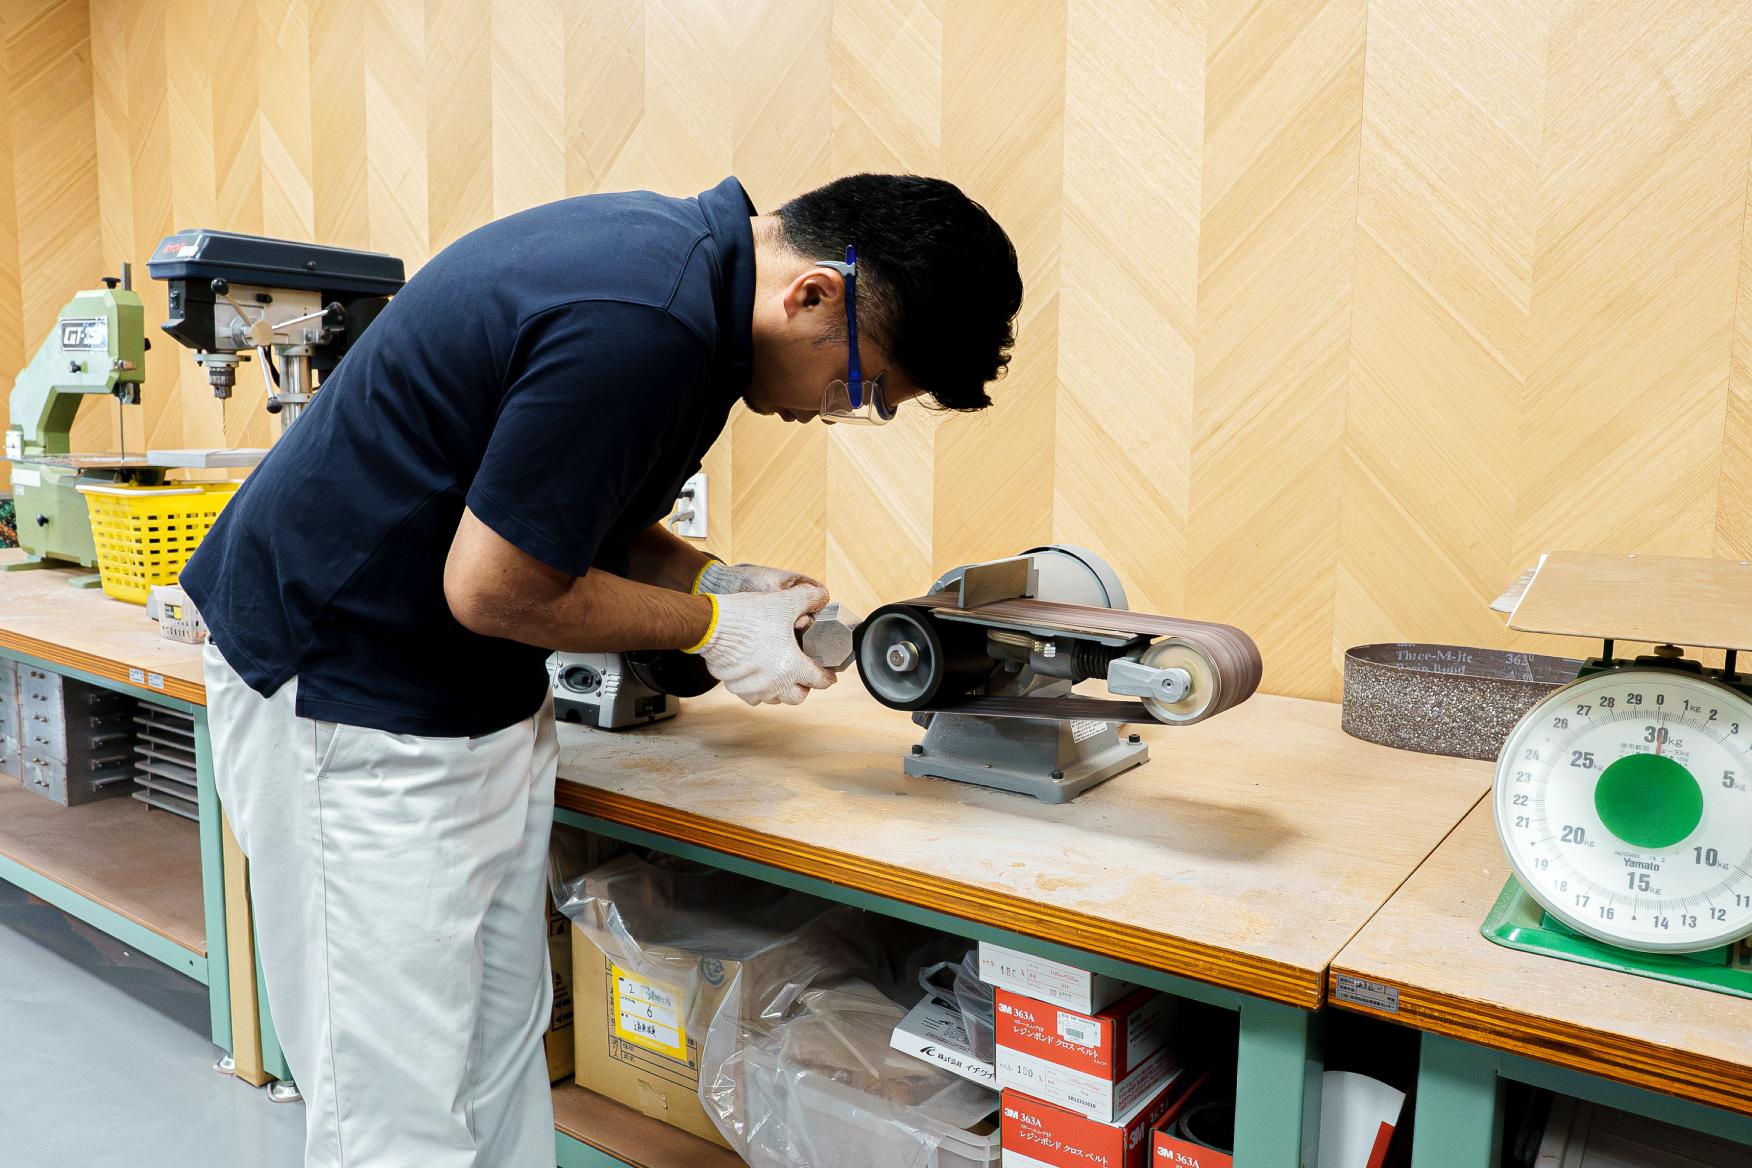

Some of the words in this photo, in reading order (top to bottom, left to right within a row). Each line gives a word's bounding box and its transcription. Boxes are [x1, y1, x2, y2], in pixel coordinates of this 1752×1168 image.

[1600, 696, 1615, 708] 28
[1626, 692, 1643, 705] 29
[1656, 694, 1665, 706] 0
[1576, 704, 1592, 716] 27
[1683, 699, 1702, 713] 1kg
[1709, 709, 1718, 721] 2
[1553, 717, 1569, 729] 26
[1730, 723, 1740, 735] 3
[1525, 749, 1540, 761] 24
[1516, 771, 1532, 783] 23
[1513, 794, 1529, 807] 22
[1515, 816, 1530, 828] 21
[1534, 858, 1549, 871] 19
[1623, 857, 1660, 872] Yamato
[1554, 880, 1568, 893] 18
[1575, 894, 1591, 908] 17
[1735, 894, 1750, 908] 11
[1599, 906, 1615, 920] 16
[1709, 907, 1727, 921] 12
[1653, 915, 1669, 930] 14
[1680, 914, 1698, 929] 13
[628, 983, 635, 994] 2
[646, 1003, 653, 1018] 6
[998, 1002, 1013, 1015] 3M
[1013, 1009, 1035, 1023] 363A
[1012, 1026, 1054, 1045] レジンボンド
[1055, 1039, 1075, 1052] クロス
[1076, 1046, 1099, 1059] ベルト
[1004, 1107, 1019, 1120] 3M
[1020, 1113, 1042, 1128] 363A
[1129, 1121, 1145, 1150] 3M
[1019, 1130, 1062, 1151] レジンボンド
[1063, 1144, 1084, 1158] クロス
[1085, 1153, 1109, 1165] ベルト
[1156, 1146, 1174, 1160] 3M
[1175, 1152, 1200, 1168] 363A
